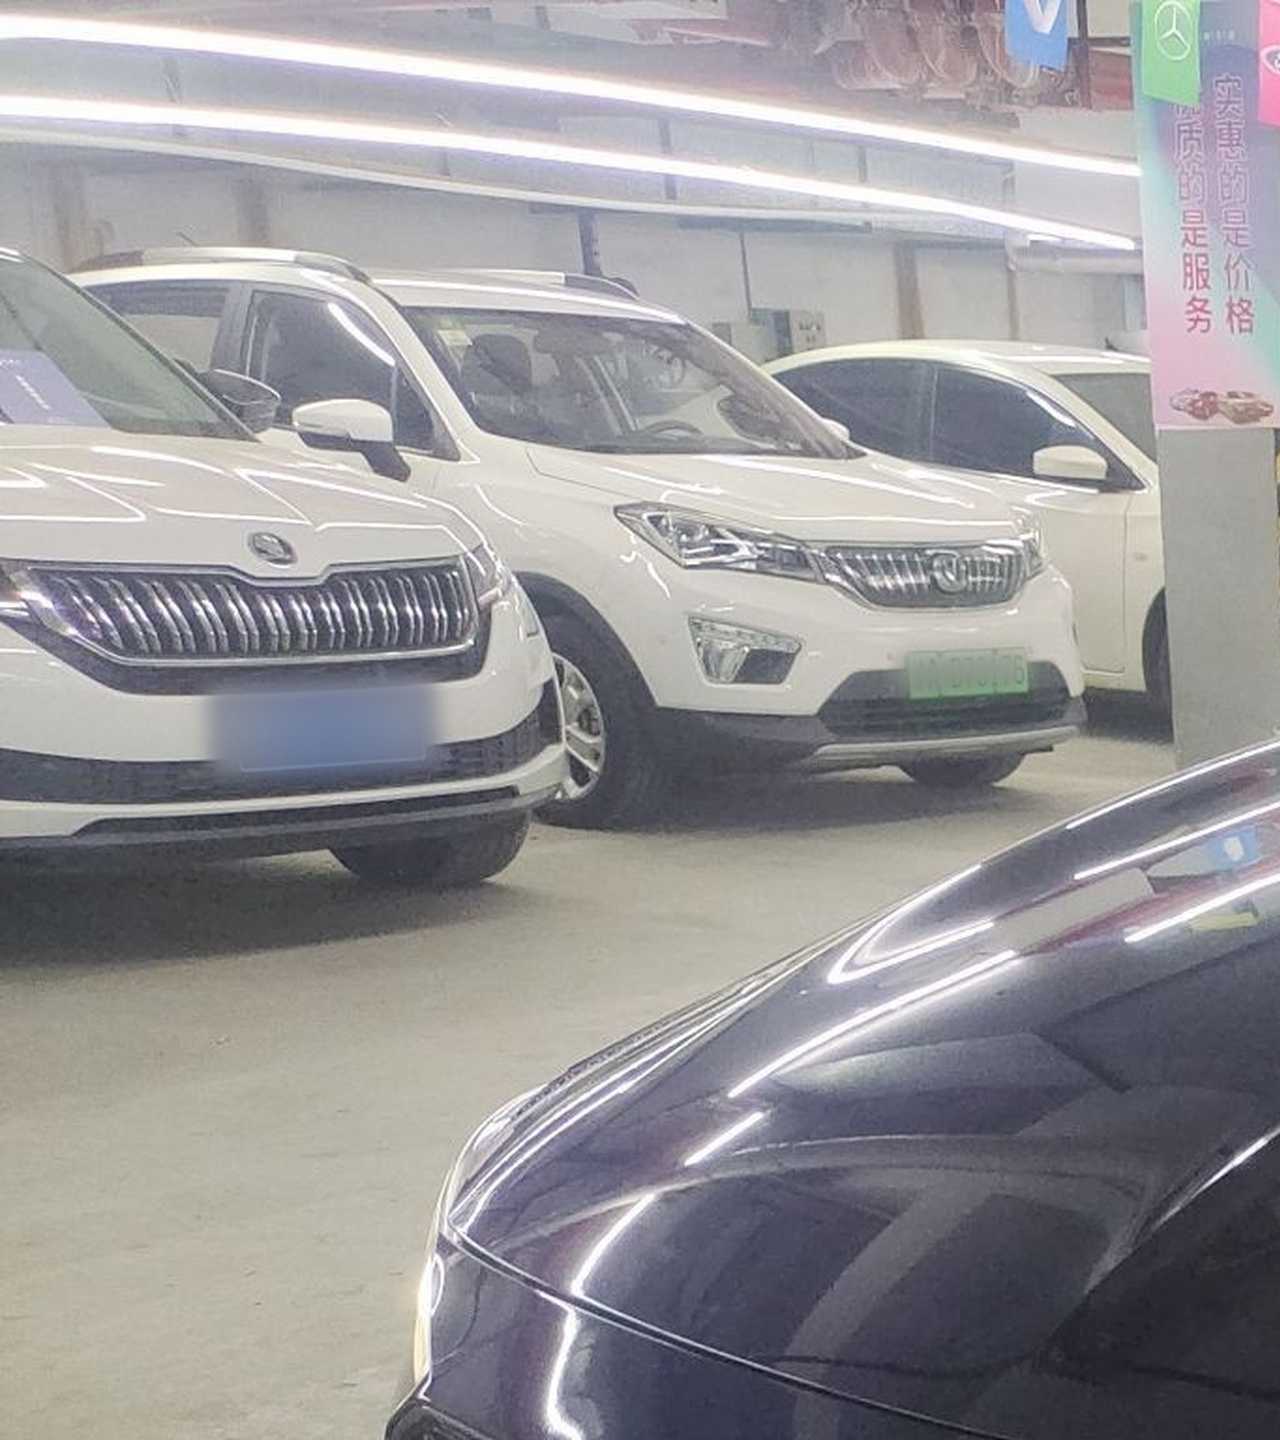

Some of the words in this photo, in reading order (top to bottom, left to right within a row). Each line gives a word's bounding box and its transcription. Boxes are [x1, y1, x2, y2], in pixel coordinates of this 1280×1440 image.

[1212, 72, 1256, 335] 实惠的是价格
